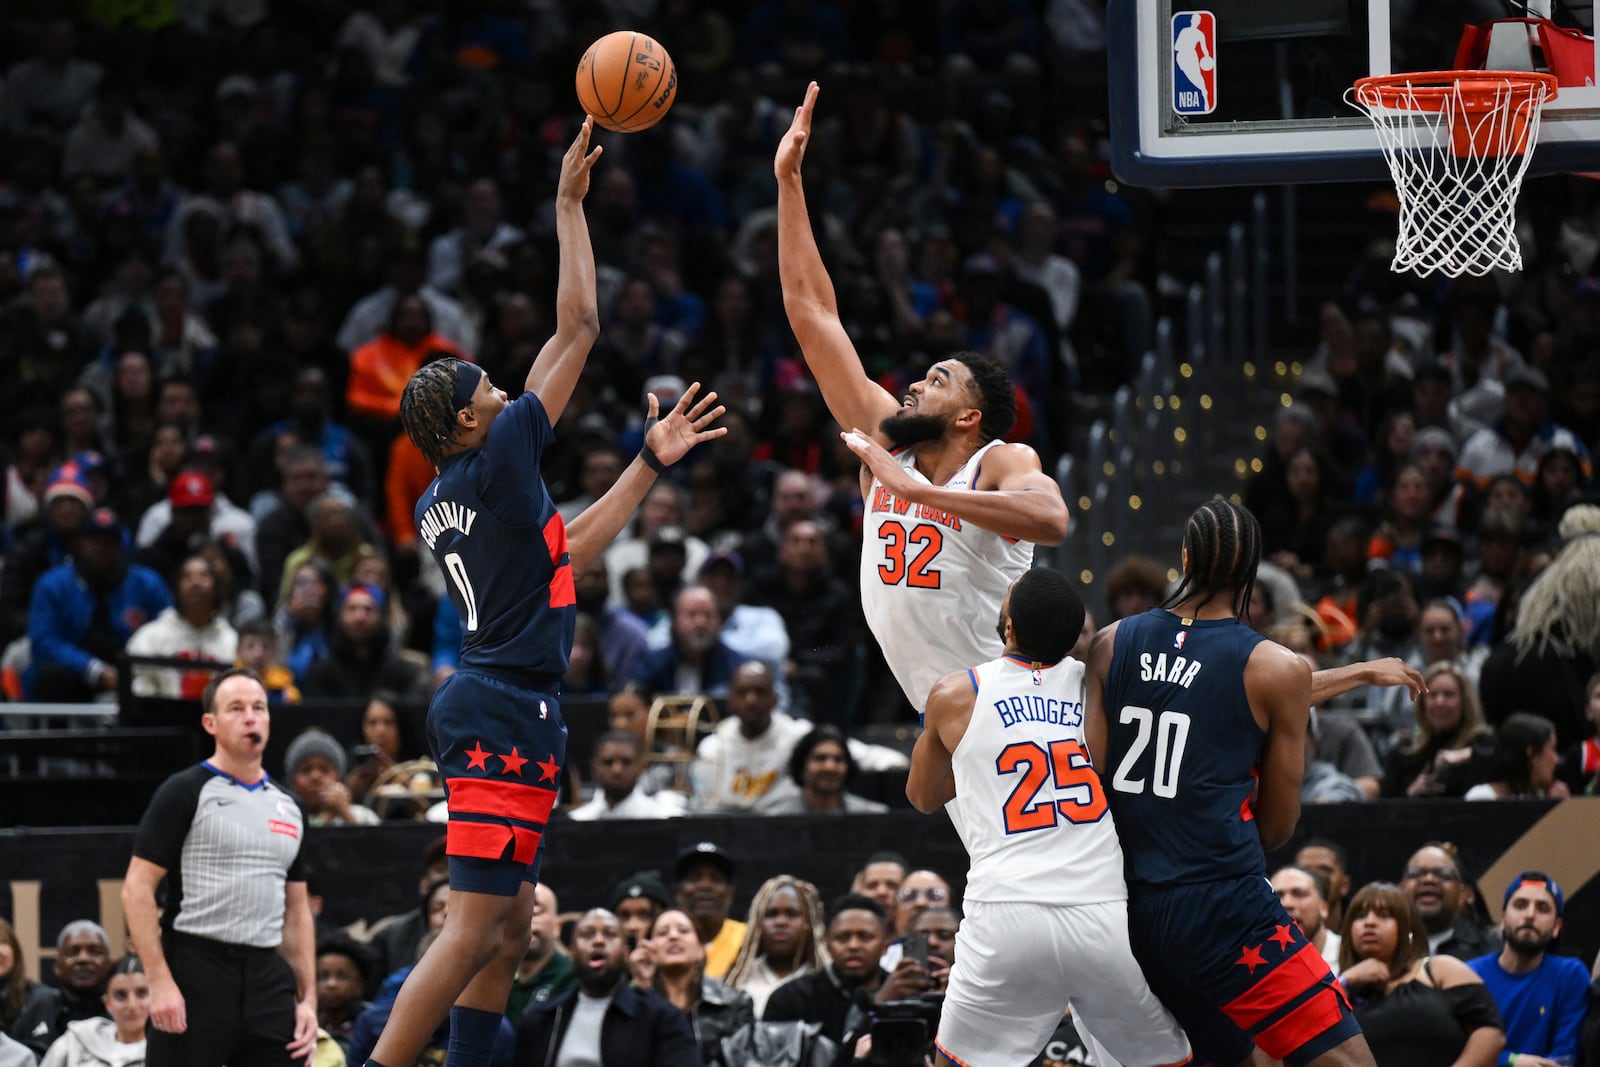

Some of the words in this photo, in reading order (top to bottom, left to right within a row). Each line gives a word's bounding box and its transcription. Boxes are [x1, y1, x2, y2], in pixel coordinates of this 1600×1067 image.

[1178, 91, 1200, 108] NBA
[872, 486, 912, 514] NEW
[420, 501, 477, 550] COULIBALY
[877, 520, 943, 589] 32
[444, 552, 478, 631] 0
[1139, 652, 1202, 689] SARR
[994, 695, 1083, 728] BRIDGES
[1111, 705, 1191, 799] 20
[995, 738, 1110, 835] 25
